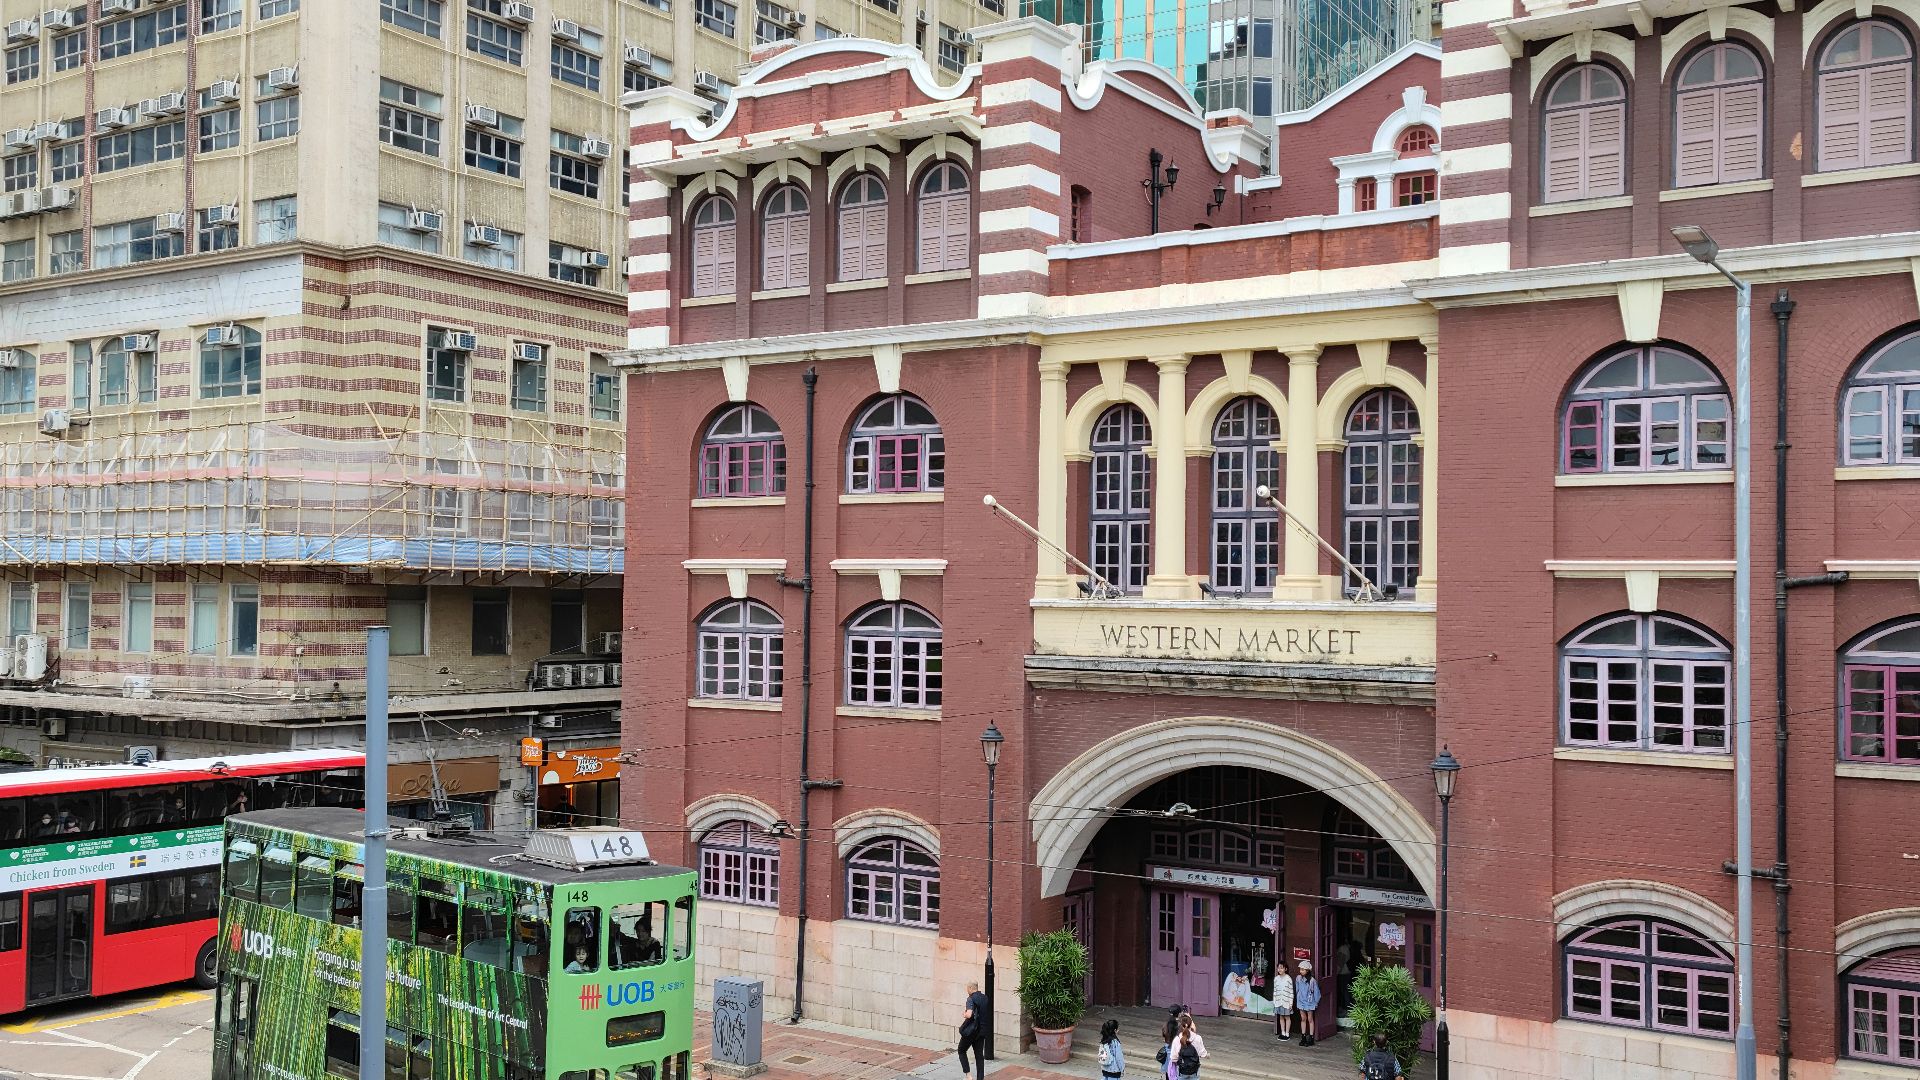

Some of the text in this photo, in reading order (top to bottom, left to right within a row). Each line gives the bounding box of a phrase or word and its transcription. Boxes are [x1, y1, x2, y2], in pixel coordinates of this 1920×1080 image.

[1100, 624, 1361, 655] WESTERN MARKET
[590, 835, 634, 859] 148
[9, 861, 115, 883] Chicken from Sweden
[566, 890, 589, 903] 148
[1392, 893, 1410, 901] Grand
[244, 928, 273, 959] UOB
[314, 946, 342, 970] Forging
[343, 957, 349, 969] a
[397, 969, 422, 990] future
[323, 969, 333, 982] the
[333, 972, 351, 987] better
[606, 979, 655, 1007] UOB
[437, 993, 528, 1030] The Lead Partner of Art Central
